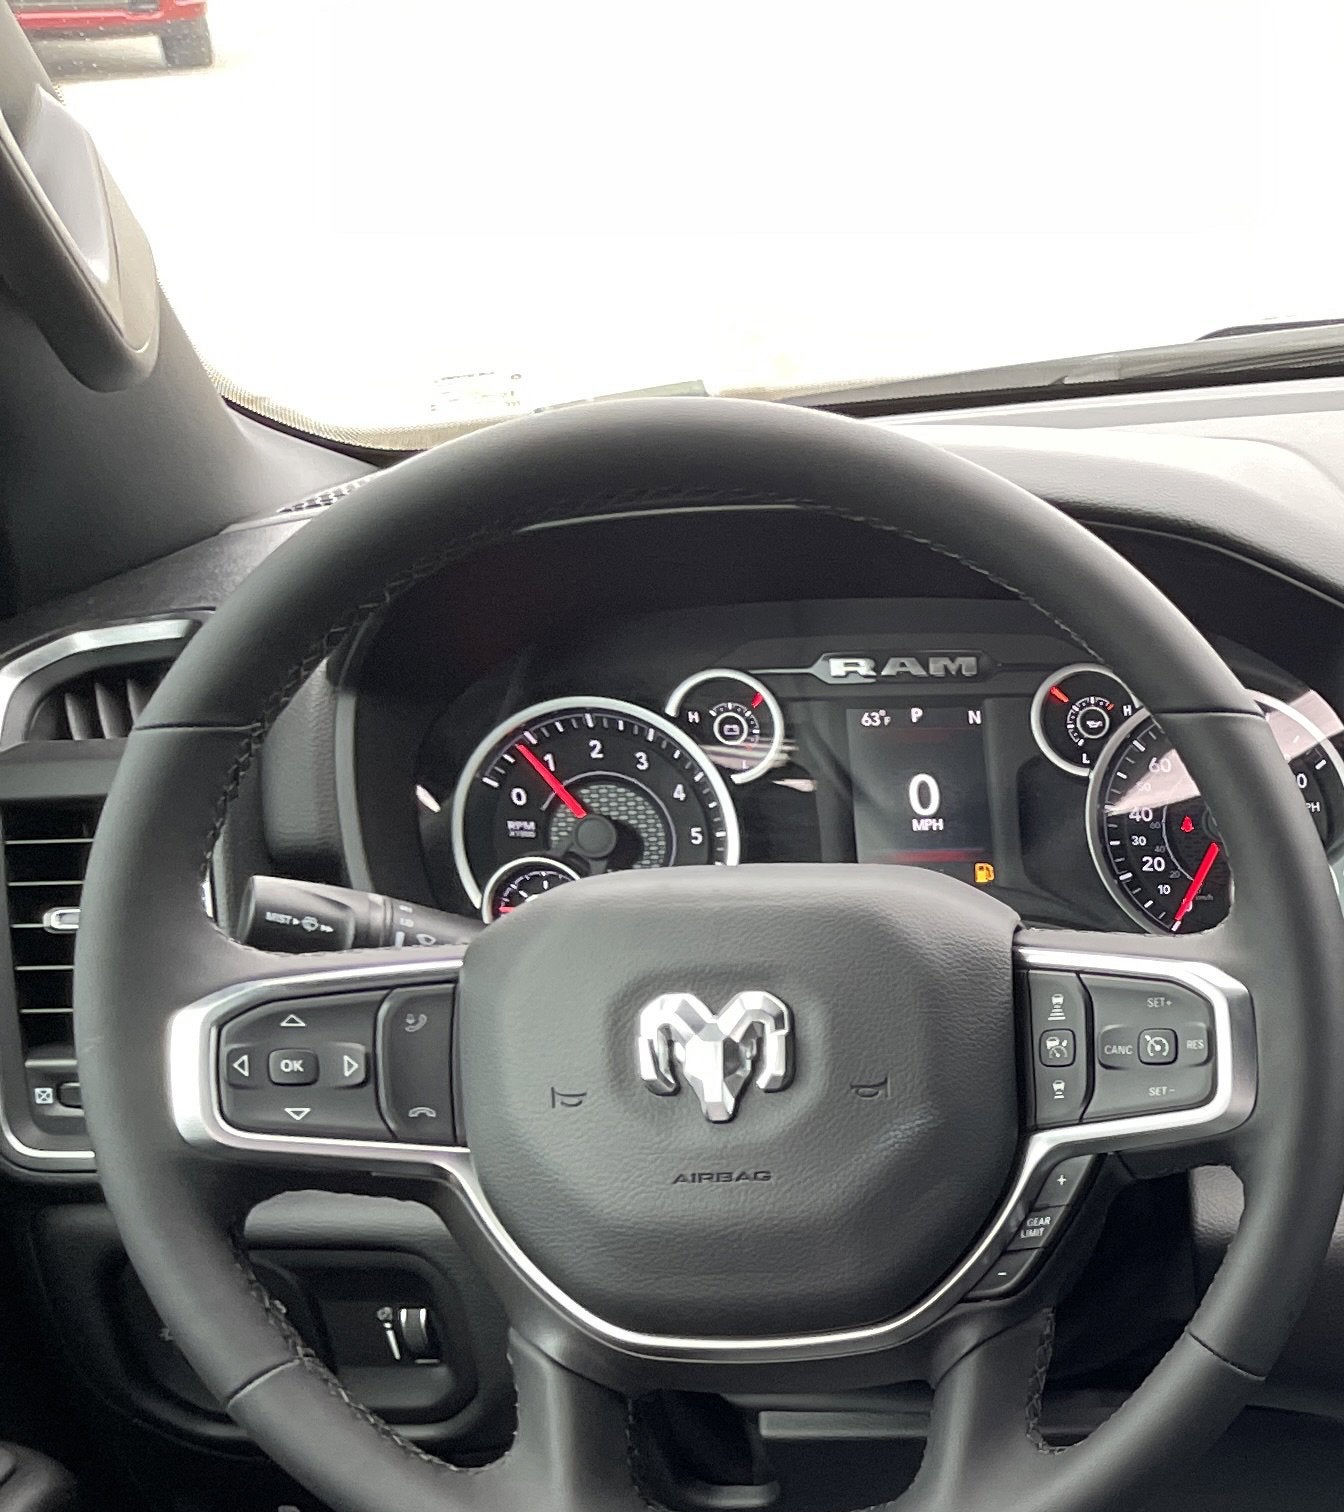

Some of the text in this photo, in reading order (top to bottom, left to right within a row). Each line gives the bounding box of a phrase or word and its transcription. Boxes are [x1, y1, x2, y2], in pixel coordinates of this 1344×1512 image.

[829, 655, 978, 678] RAM
[687, 710, 700, 723] H
[910, 706, 923, 723] P
[967, 709, 982, 724] N
[1122, 704, 1133, 717] H
[588, 739, 604, 759] 2
[543, 752, 556, 772] 1
[634, 751, 649, 771] 3
[1081, 752, 1091, 764] L
[1148, 757, 1172, 774] 60
[510, 787, 528, 806] 0
[672, 783, 686, 801] 4
[908, 773, 941, 817] 0
[1129, 806, 1154, 822] 40
[911, 818, 944, 832] MPH
[690, 827, 703, 845] 5
[1131, 835, 1147, 847] 30
[1141, 855, 1166, 873] 20
[1156, 884, 1171, 896] 10
[265, 911, 293, 925] MIST
[1104, 1044, 1134, 1056] CANC
[1186, 1039, 1205, 1051] RES
[280, 1059, 304, 1073] OK
[671, 1170, 773, 1185] AIRBAG
[1027, 1216, 1051, 1227] GEAR
[1020, 1227, 1045, 1238] LIMIT
